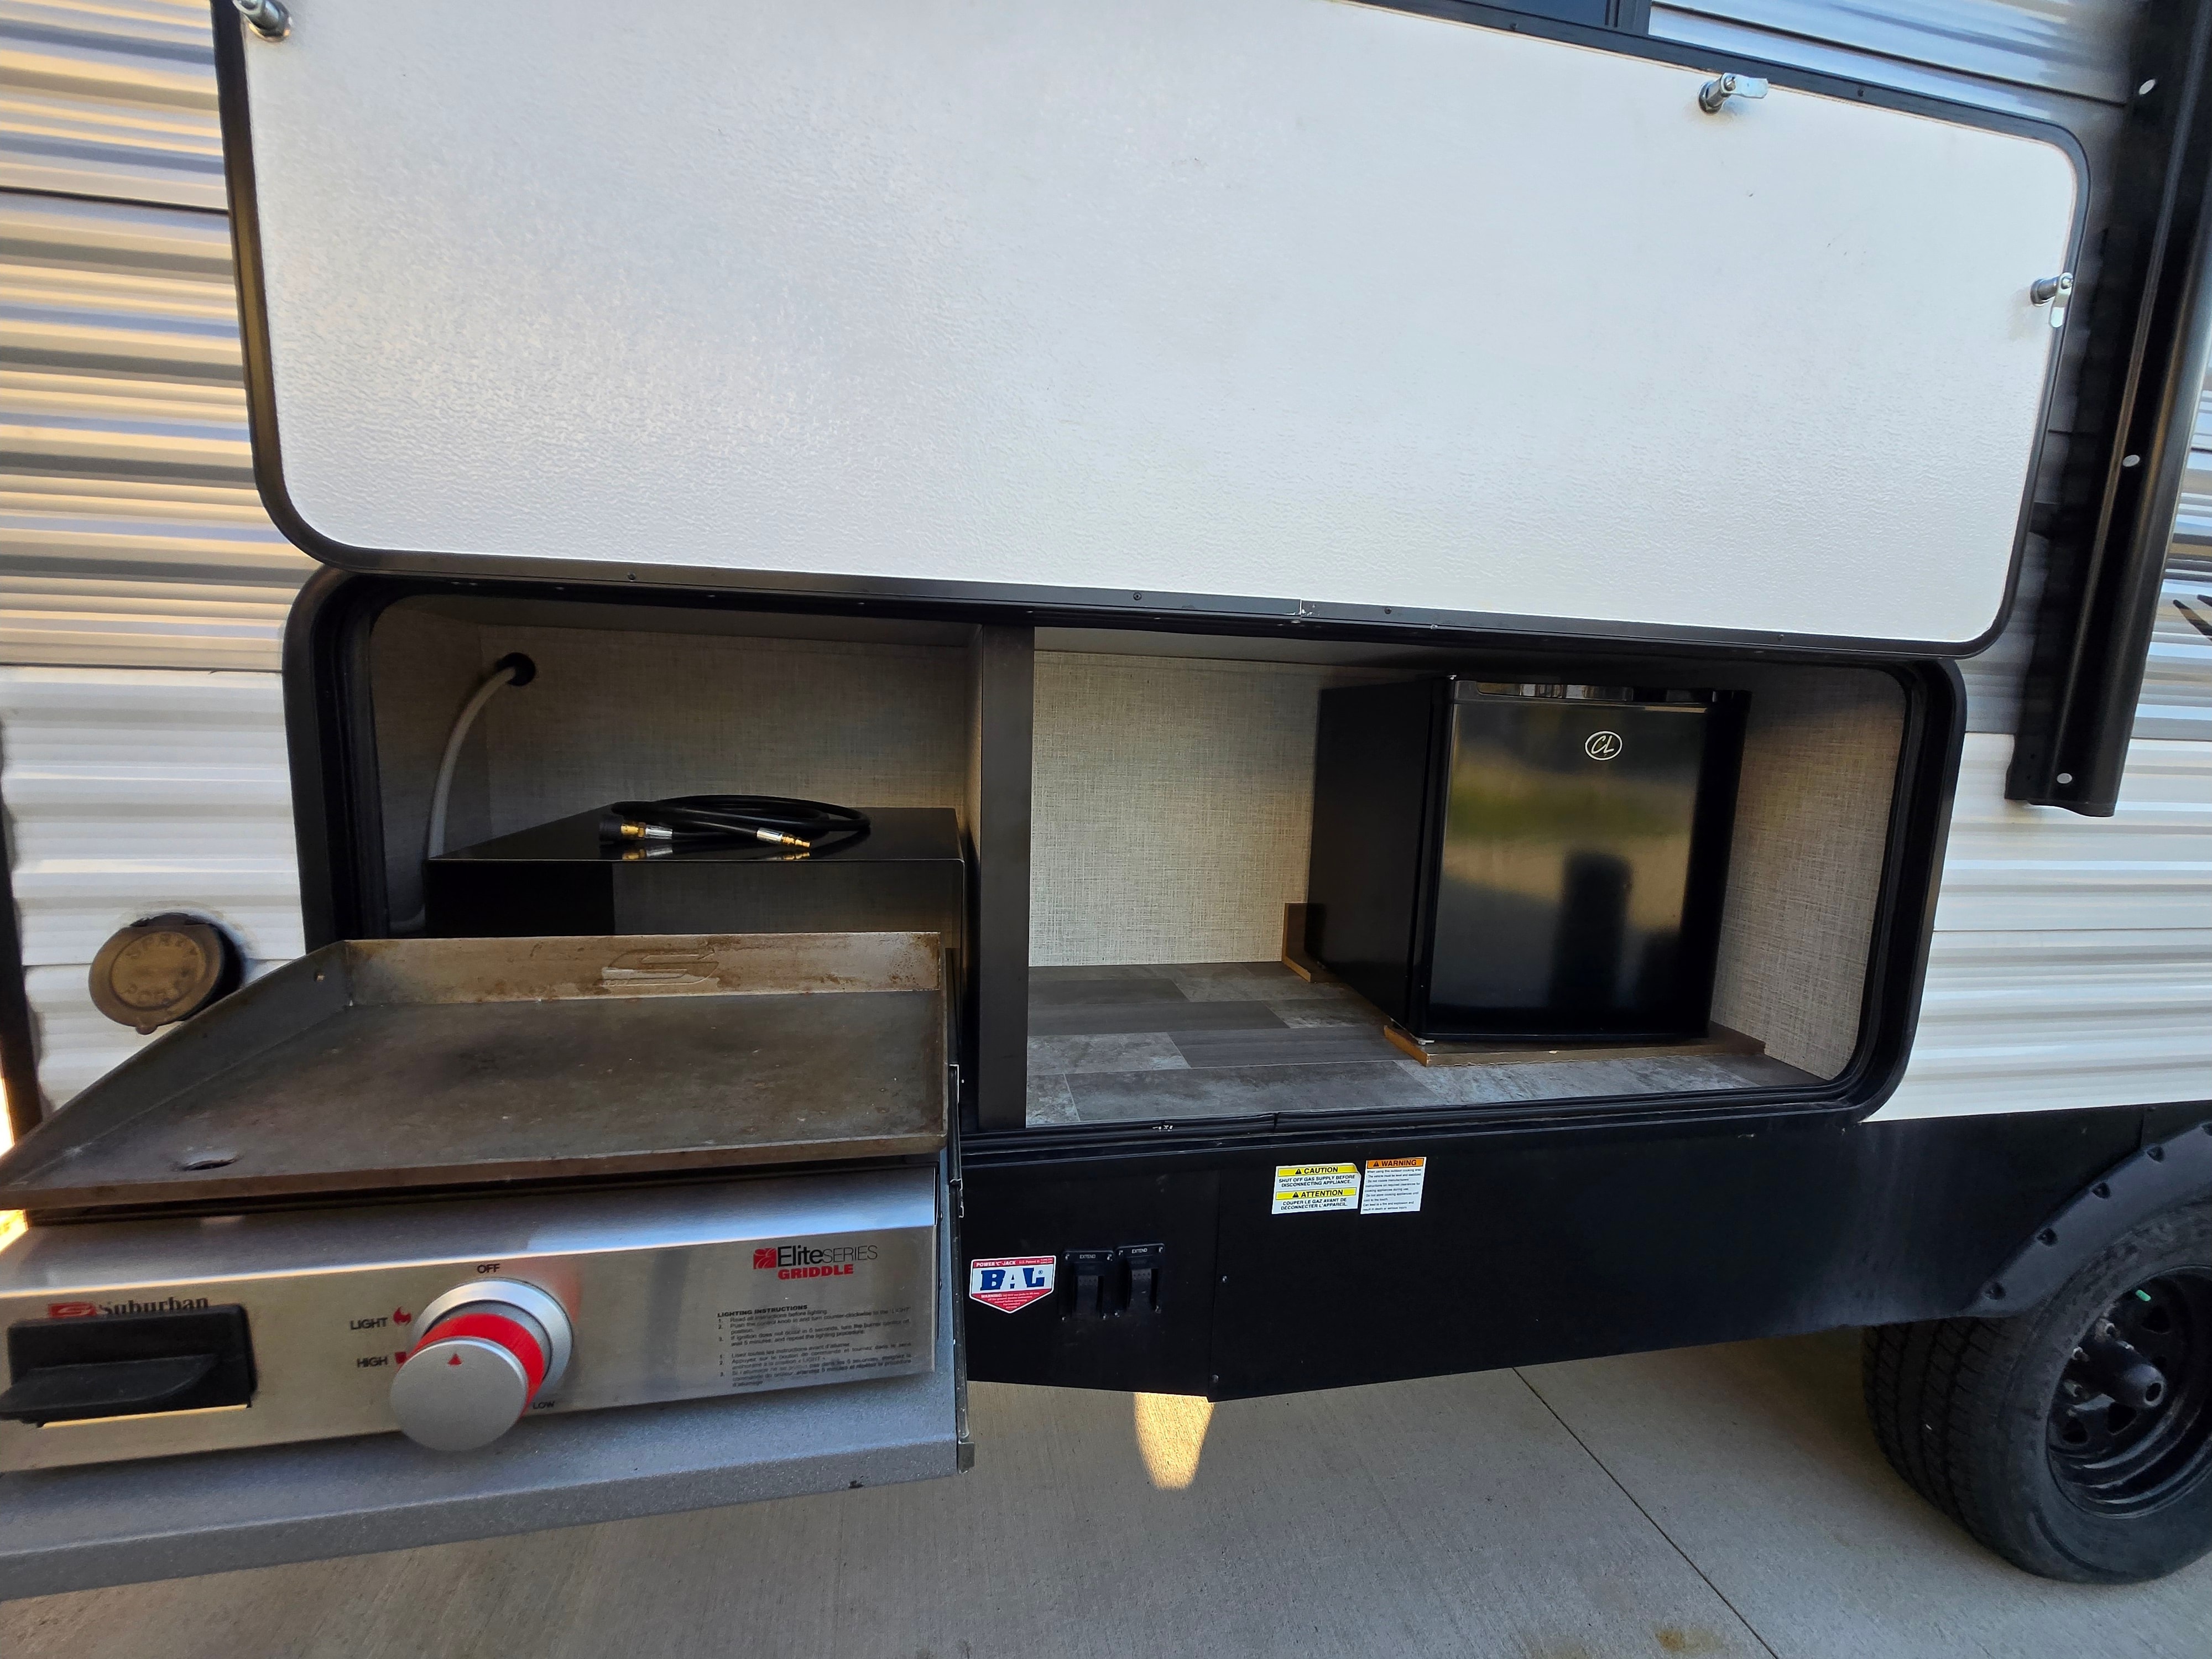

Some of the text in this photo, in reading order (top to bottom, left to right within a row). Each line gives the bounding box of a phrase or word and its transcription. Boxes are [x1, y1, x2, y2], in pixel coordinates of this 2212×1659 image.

[1301, 1190, 1343, 1198] ATTENTION
[477, 1264, 500, 1274] OFF
[778, 1264, 854, 1280] GRIDDLE
[754, 1305, 807, 1313] INSTRUCTIONS
[350, 1317, 388, 1330] LIGHT
[356, 1356, 388, 1368] HIGH
[532, 1400, 555, 1410] LOW
